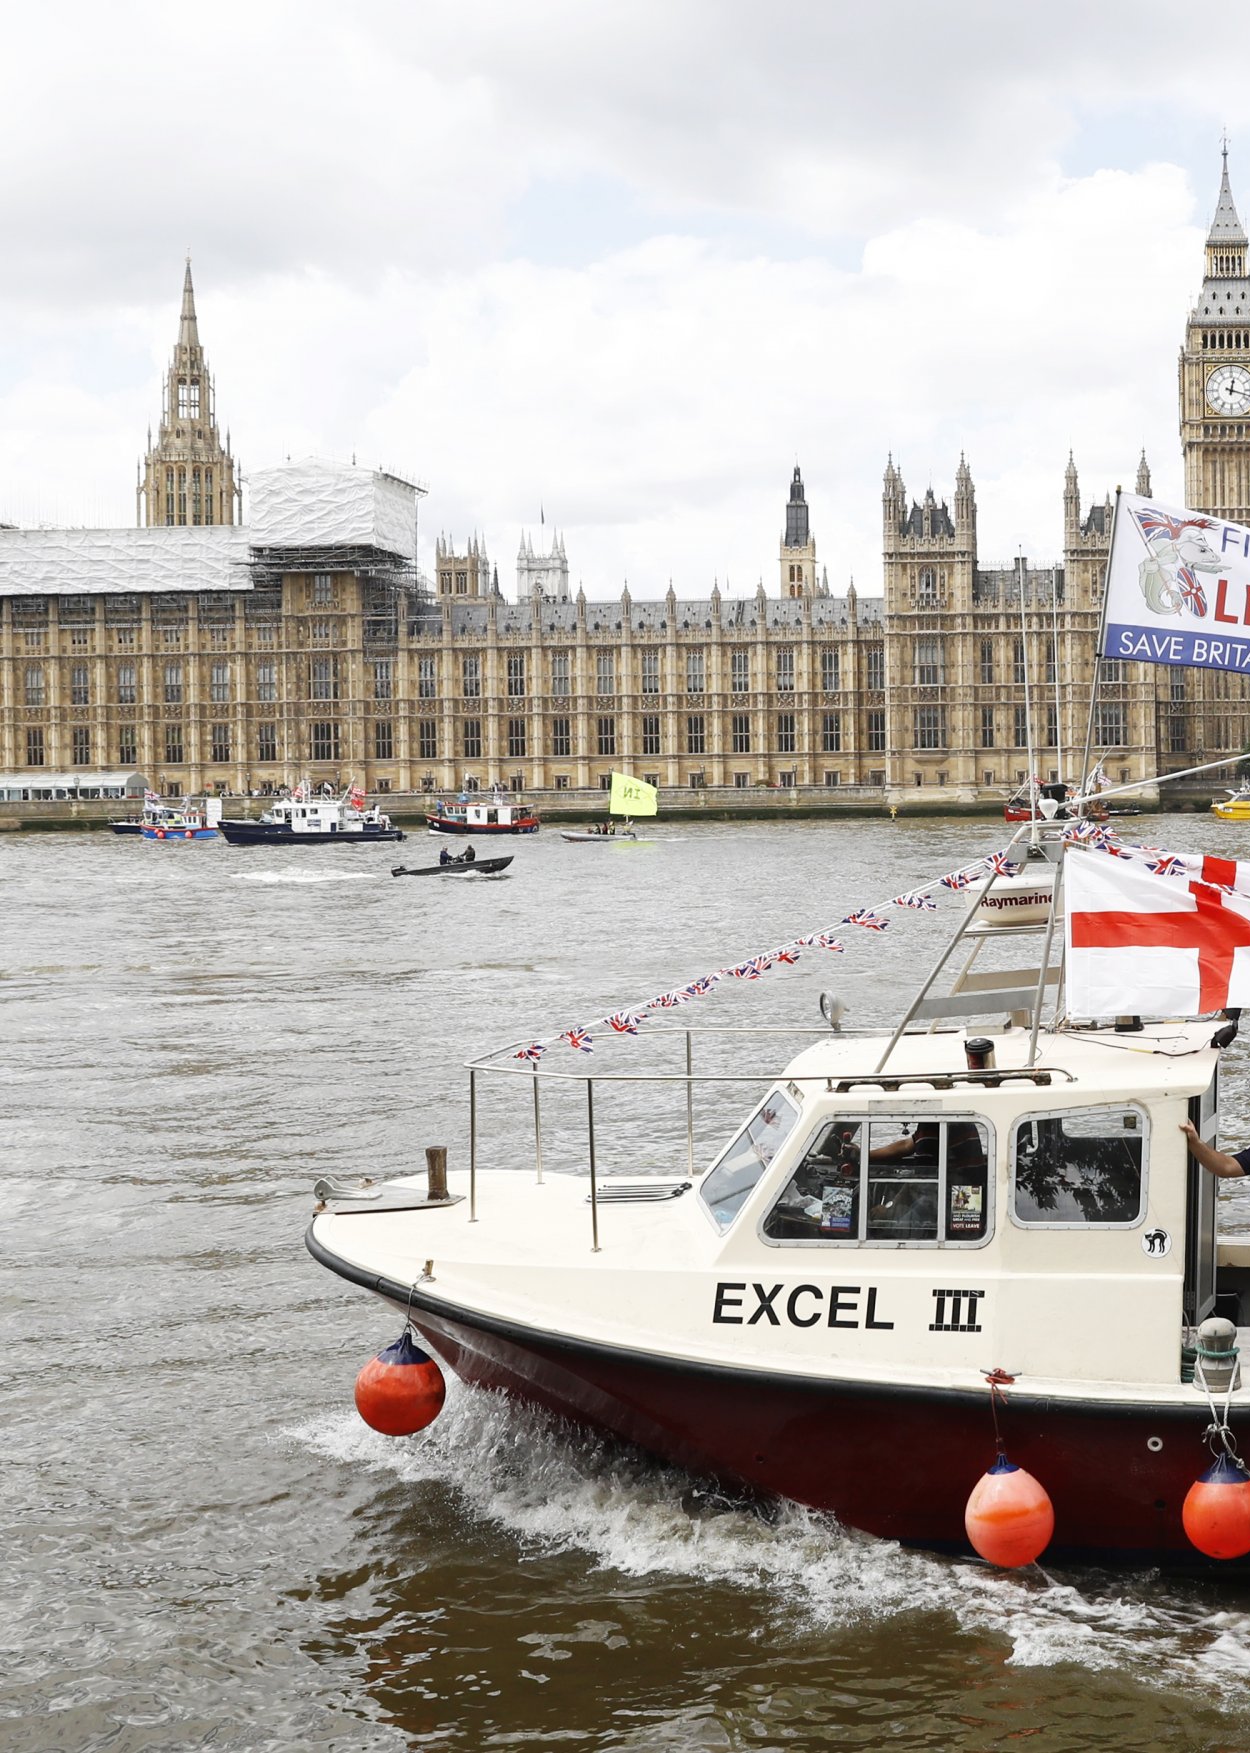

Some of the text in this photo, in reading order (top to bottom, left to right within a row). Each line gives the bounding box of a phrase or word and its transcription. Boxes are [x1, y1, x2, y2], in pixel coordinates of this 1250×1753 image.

[1119, 631, 1184, 660] SAVE
[712, 1281, 985, 1332] EXCEL III
